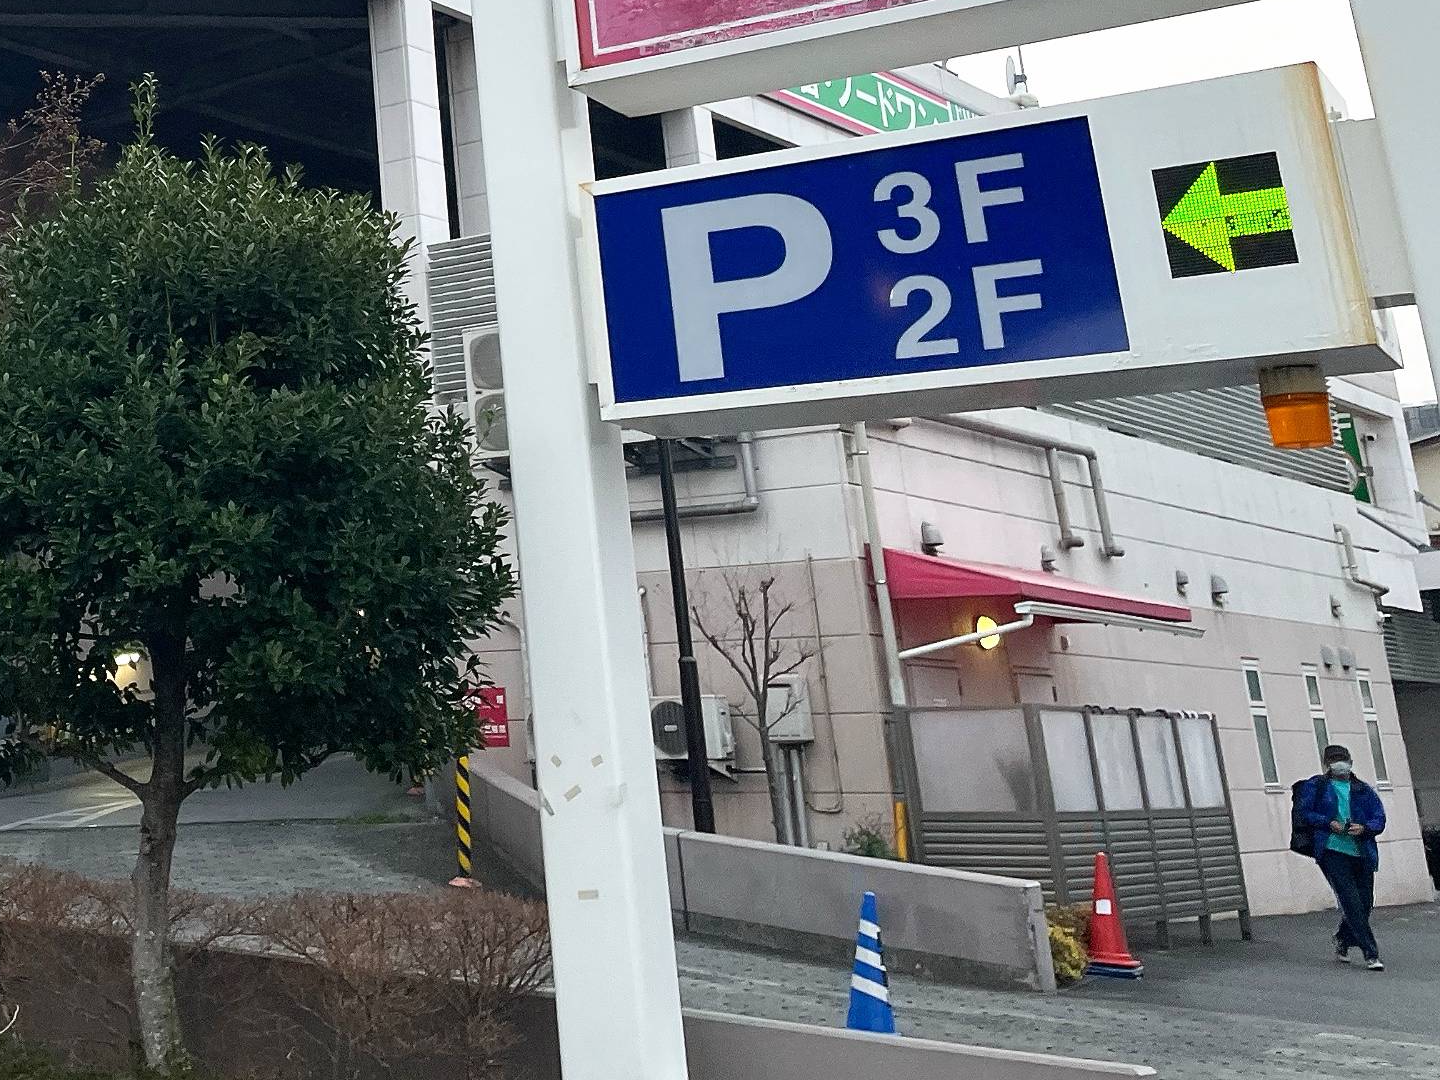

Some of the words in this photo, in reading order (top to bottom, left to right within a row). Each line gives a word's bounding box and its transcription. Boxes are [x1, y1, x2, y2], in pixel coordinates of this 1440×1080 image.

[873, 152, 1025, 254] 3F
[661, 193, 834, 382] P
[889, 259, 1043, 360] 2F
